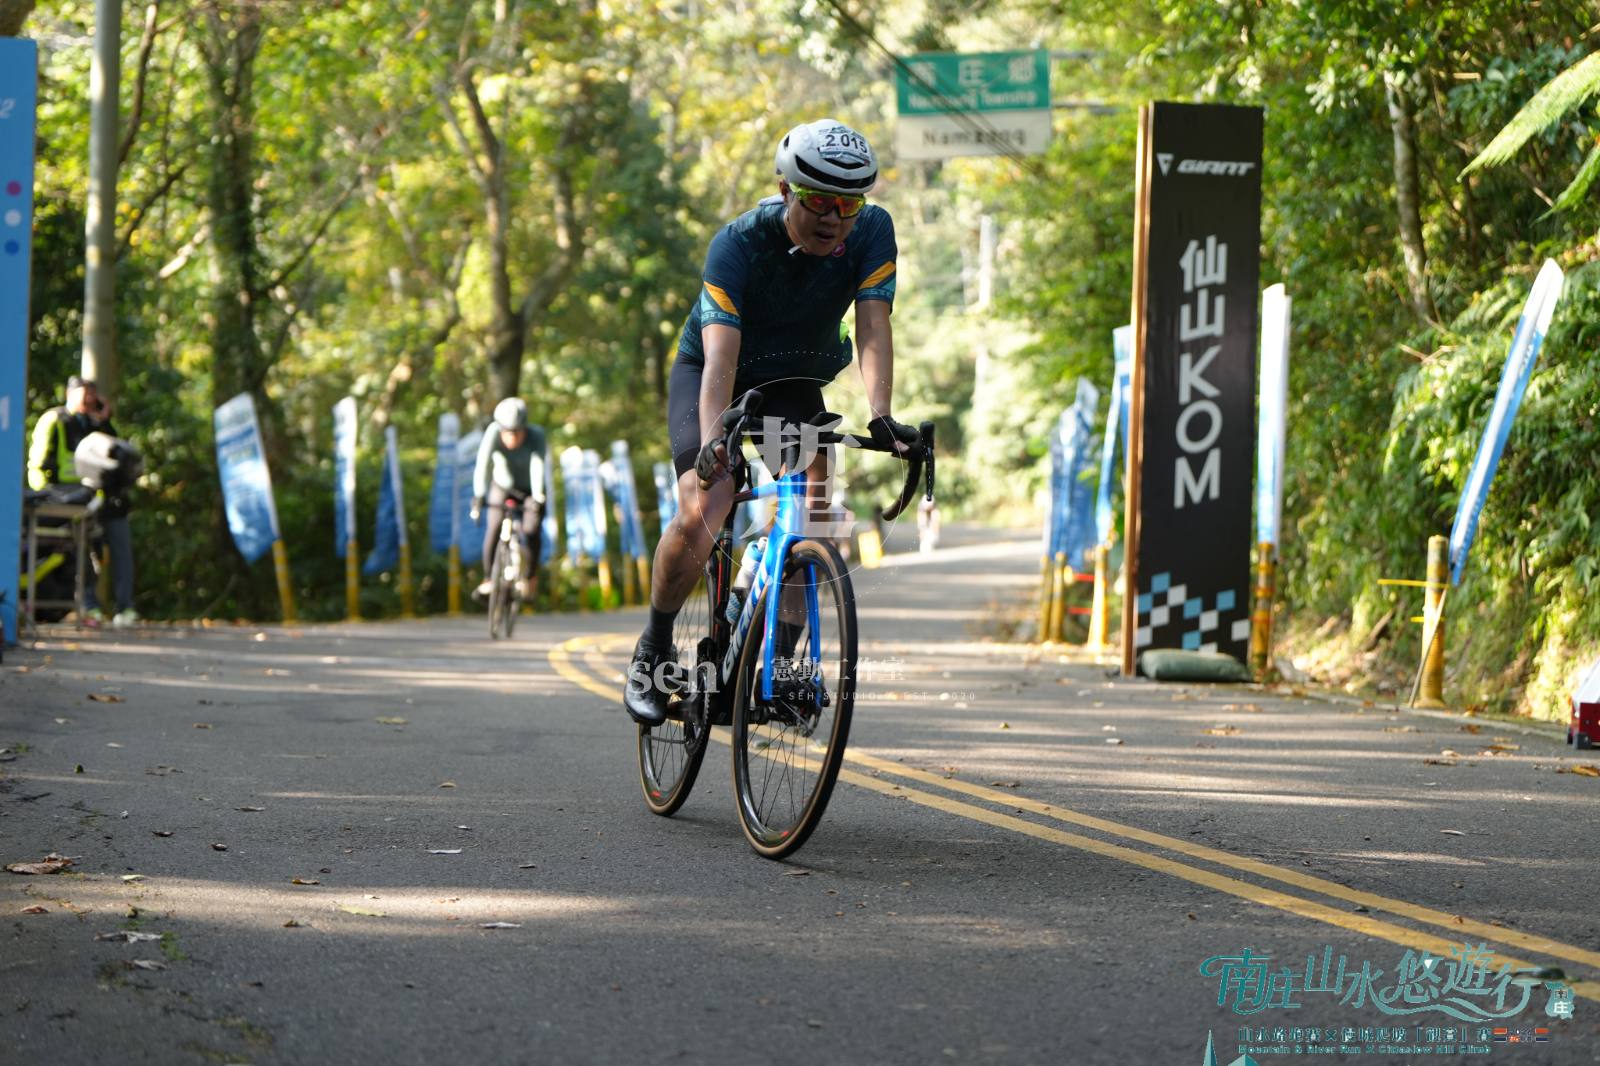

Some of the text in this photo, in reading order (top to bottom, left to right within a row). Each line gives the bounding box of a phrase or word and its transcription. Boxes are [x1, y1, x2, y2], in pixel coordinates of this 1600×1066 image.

[825, 134, 868, 153] 2015
[1177, 159, 1257, 176] GIANT
[1174, 234, 1227, 509] 仙山 KOM
